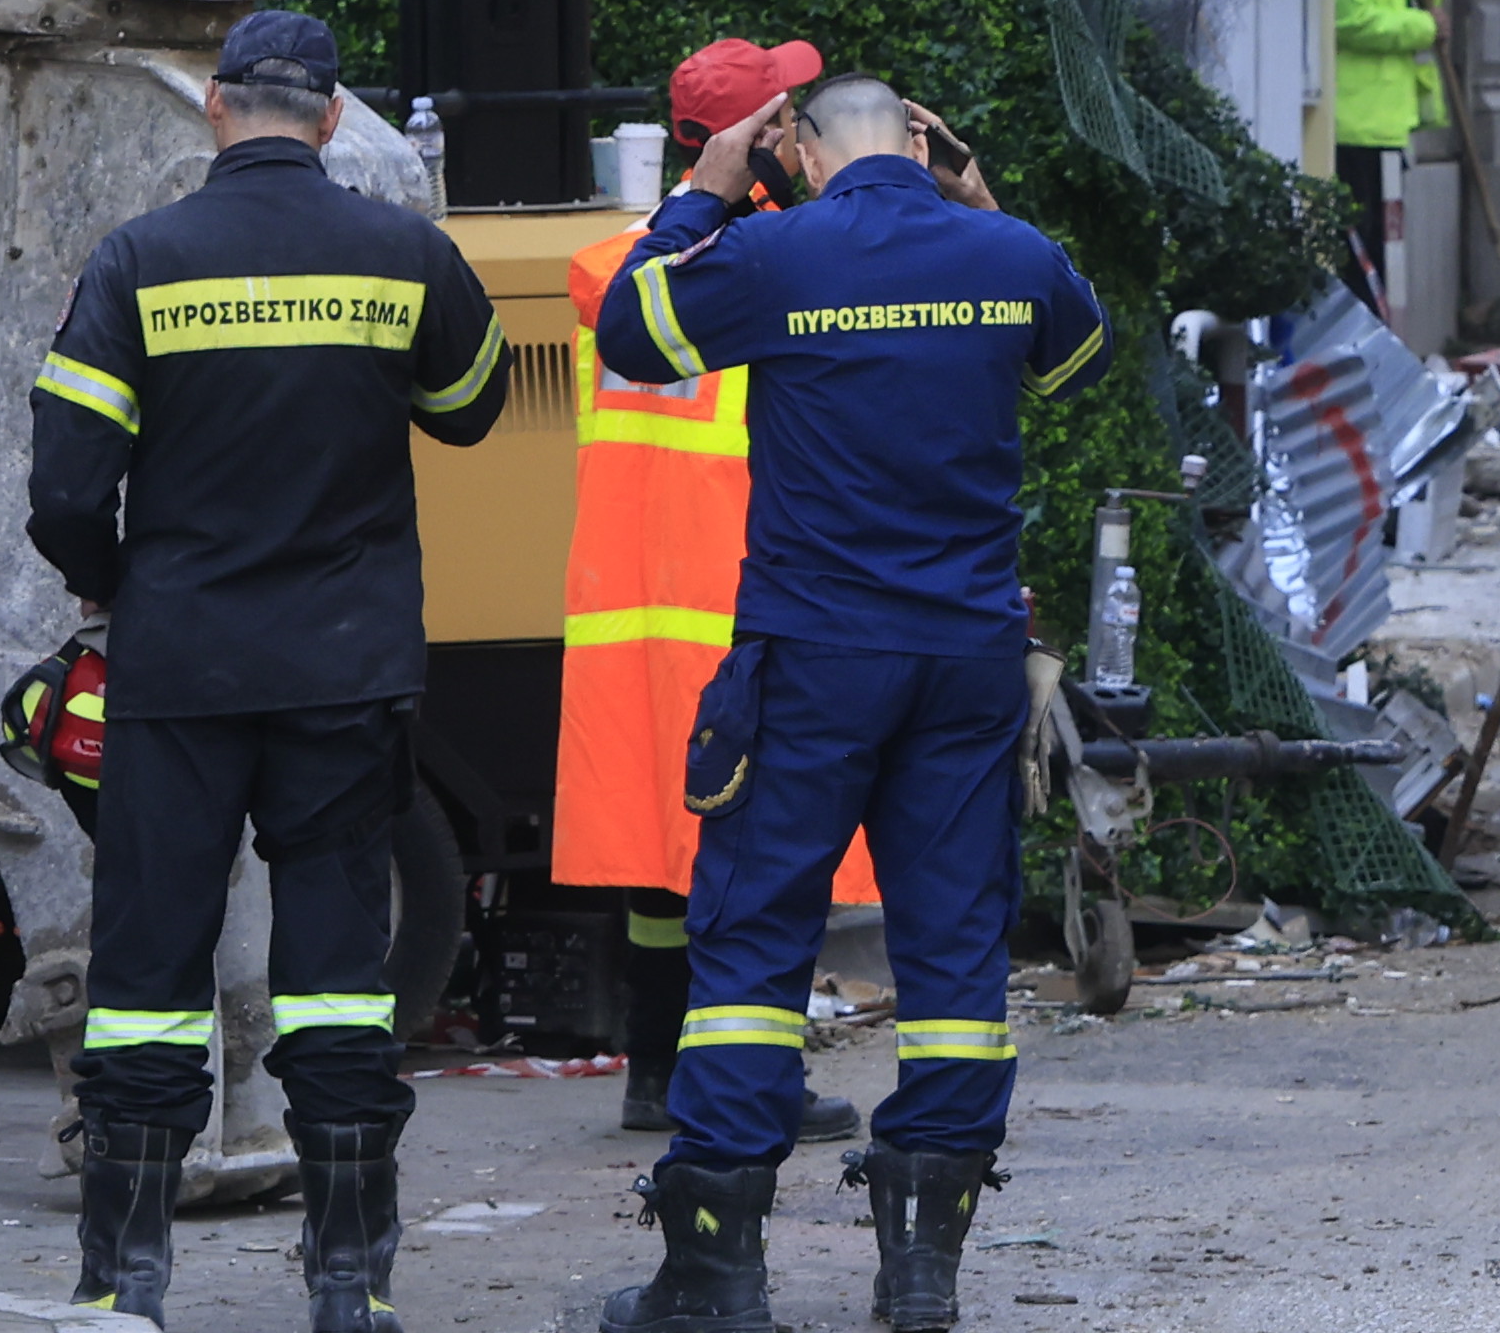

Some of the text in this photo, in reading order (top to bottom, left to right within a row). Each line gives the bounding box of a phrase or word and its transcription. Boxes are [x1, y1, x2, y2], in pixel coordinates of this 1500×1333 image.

[151, 298, 410, 332] ΠΥΡΟΣΒΕΣΤΙΚΟ ΣΩΜΑ
[787, 300, 1033, 335] ΠΥΡΟΣΒΕΣΤΙΚΟ ΣΩΜΑ
